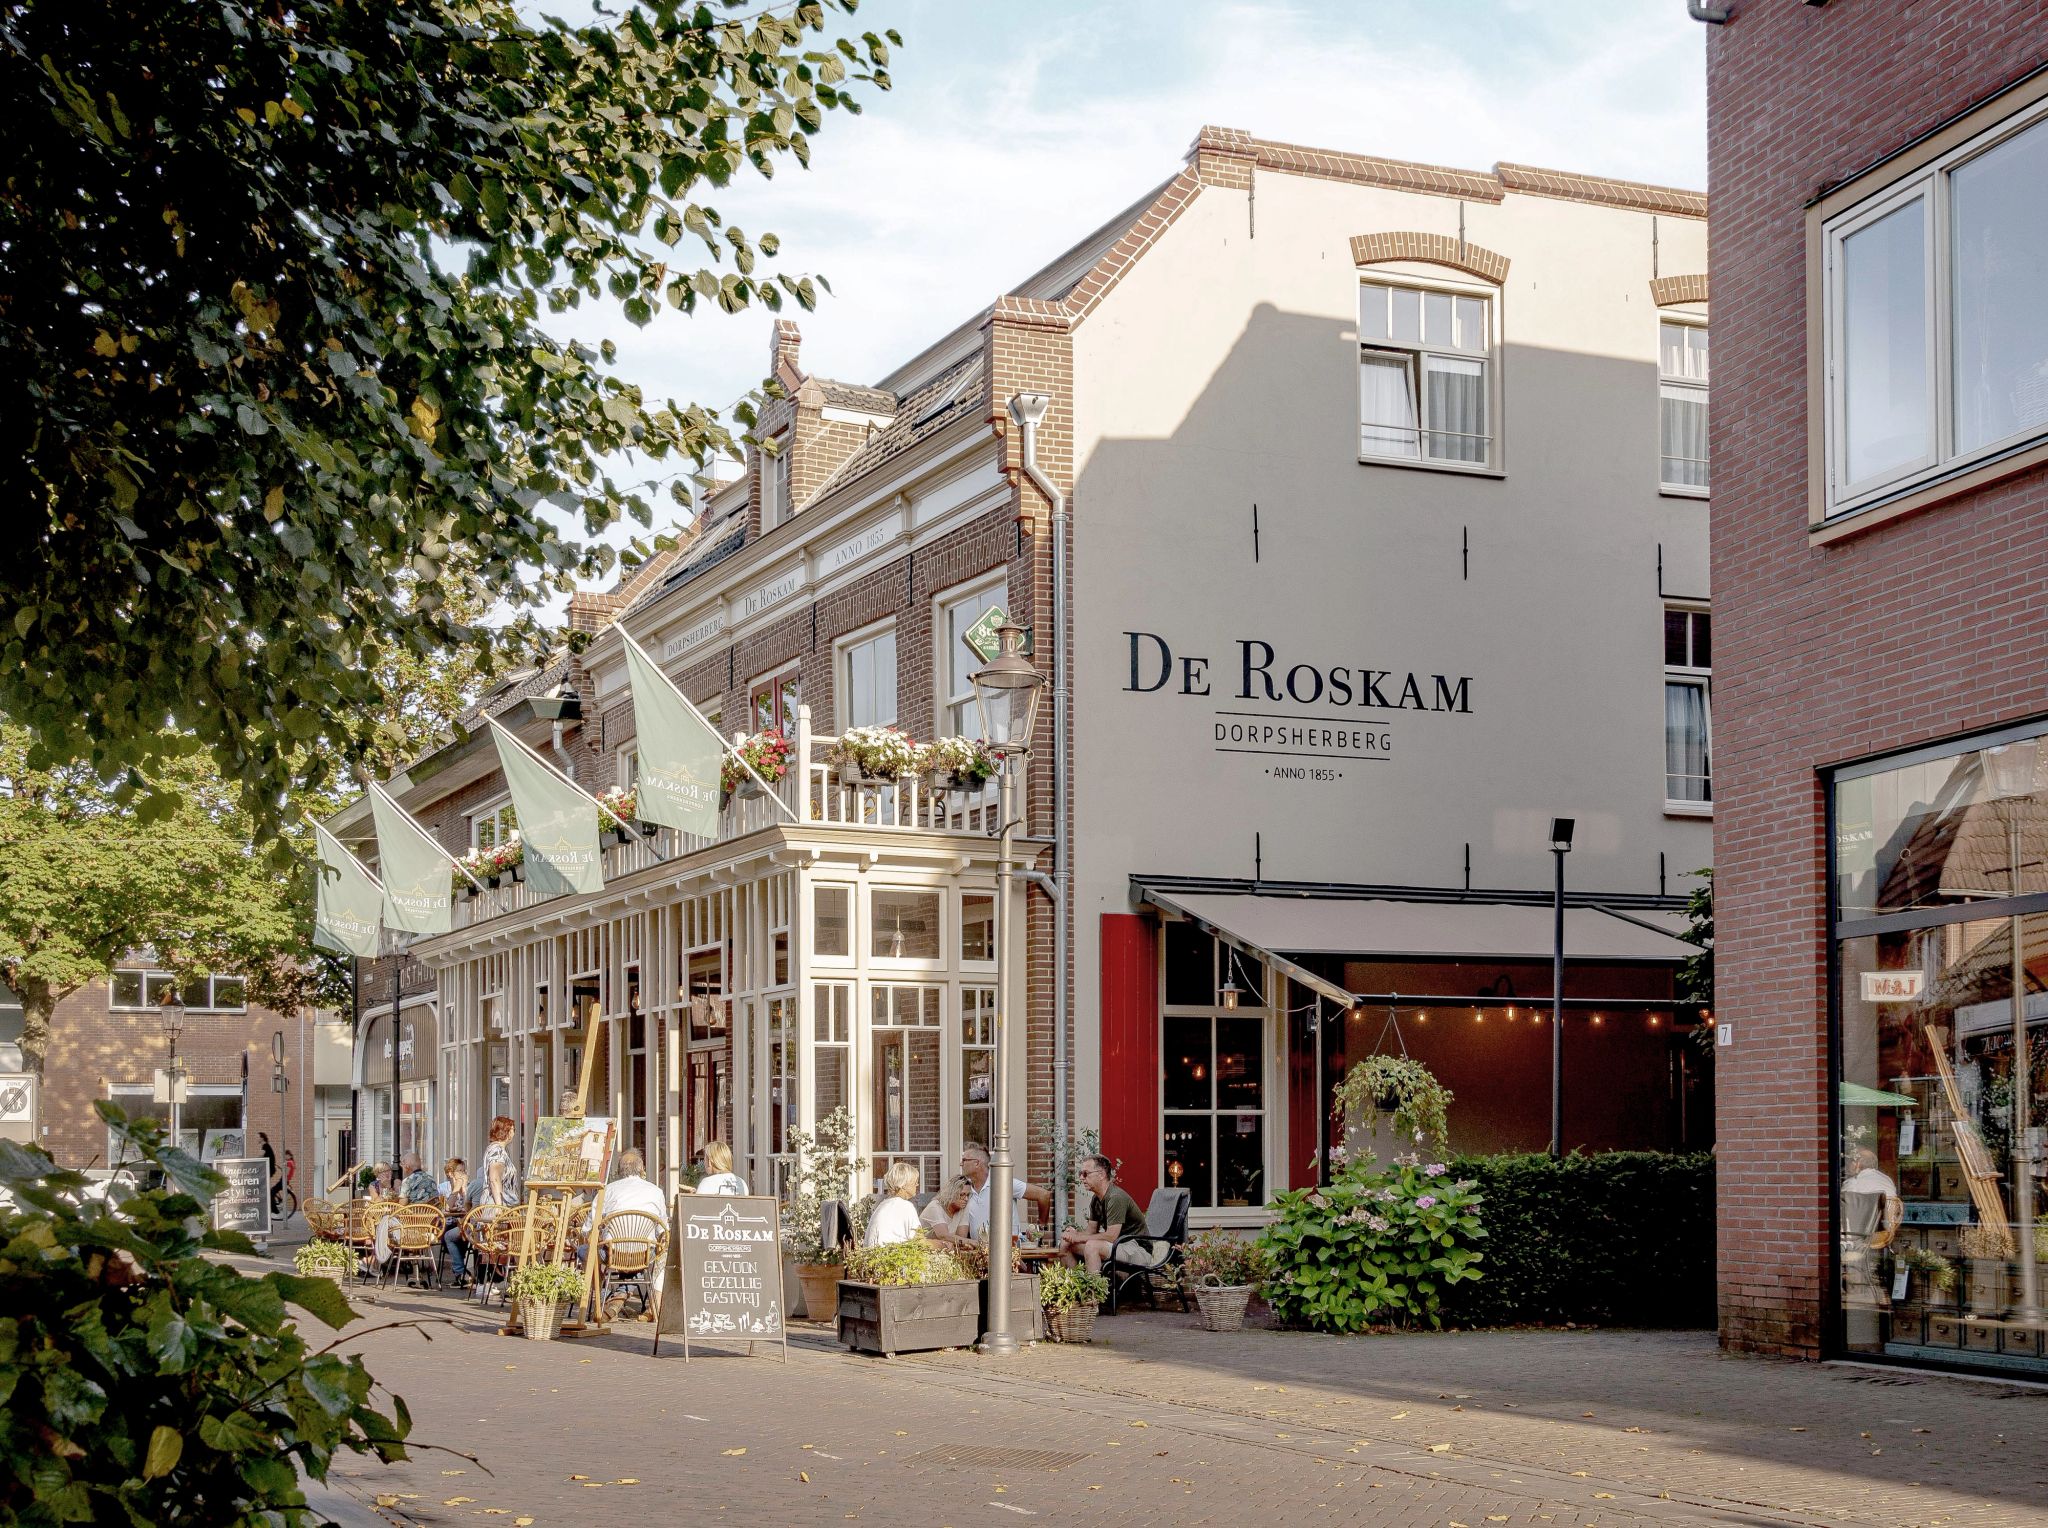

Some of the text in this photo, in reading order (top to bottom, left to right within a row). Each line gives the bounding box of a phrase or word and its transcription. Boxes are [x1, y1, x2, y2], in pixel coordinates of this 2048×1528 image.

[834, 528, 885, 566] ANNO 1855
[744, 578, 796, 617] DE ROSKAM
[668, 616, 723, 656] DORPSHERBERG
[1122, 631, 1474, 714] DE ROSKAM
[1215, 723, 1391, 751] DORPSHERBERG
[1273, 766, 1335, 781] ANNO 1855
[1721, 1027, 1728, 1043] 7
[229, 1176, 260, 1186] leuren
[223, 1188, 260, 1199] stylen
[686, 1223, 774, 1242] DE ROSKAM
[703, 1260, 758, 1275] GEWOON
[701, 1276, 762, 1289] GEZELLIG
[703, 1291, 760, 1308] GASTVRIJ
